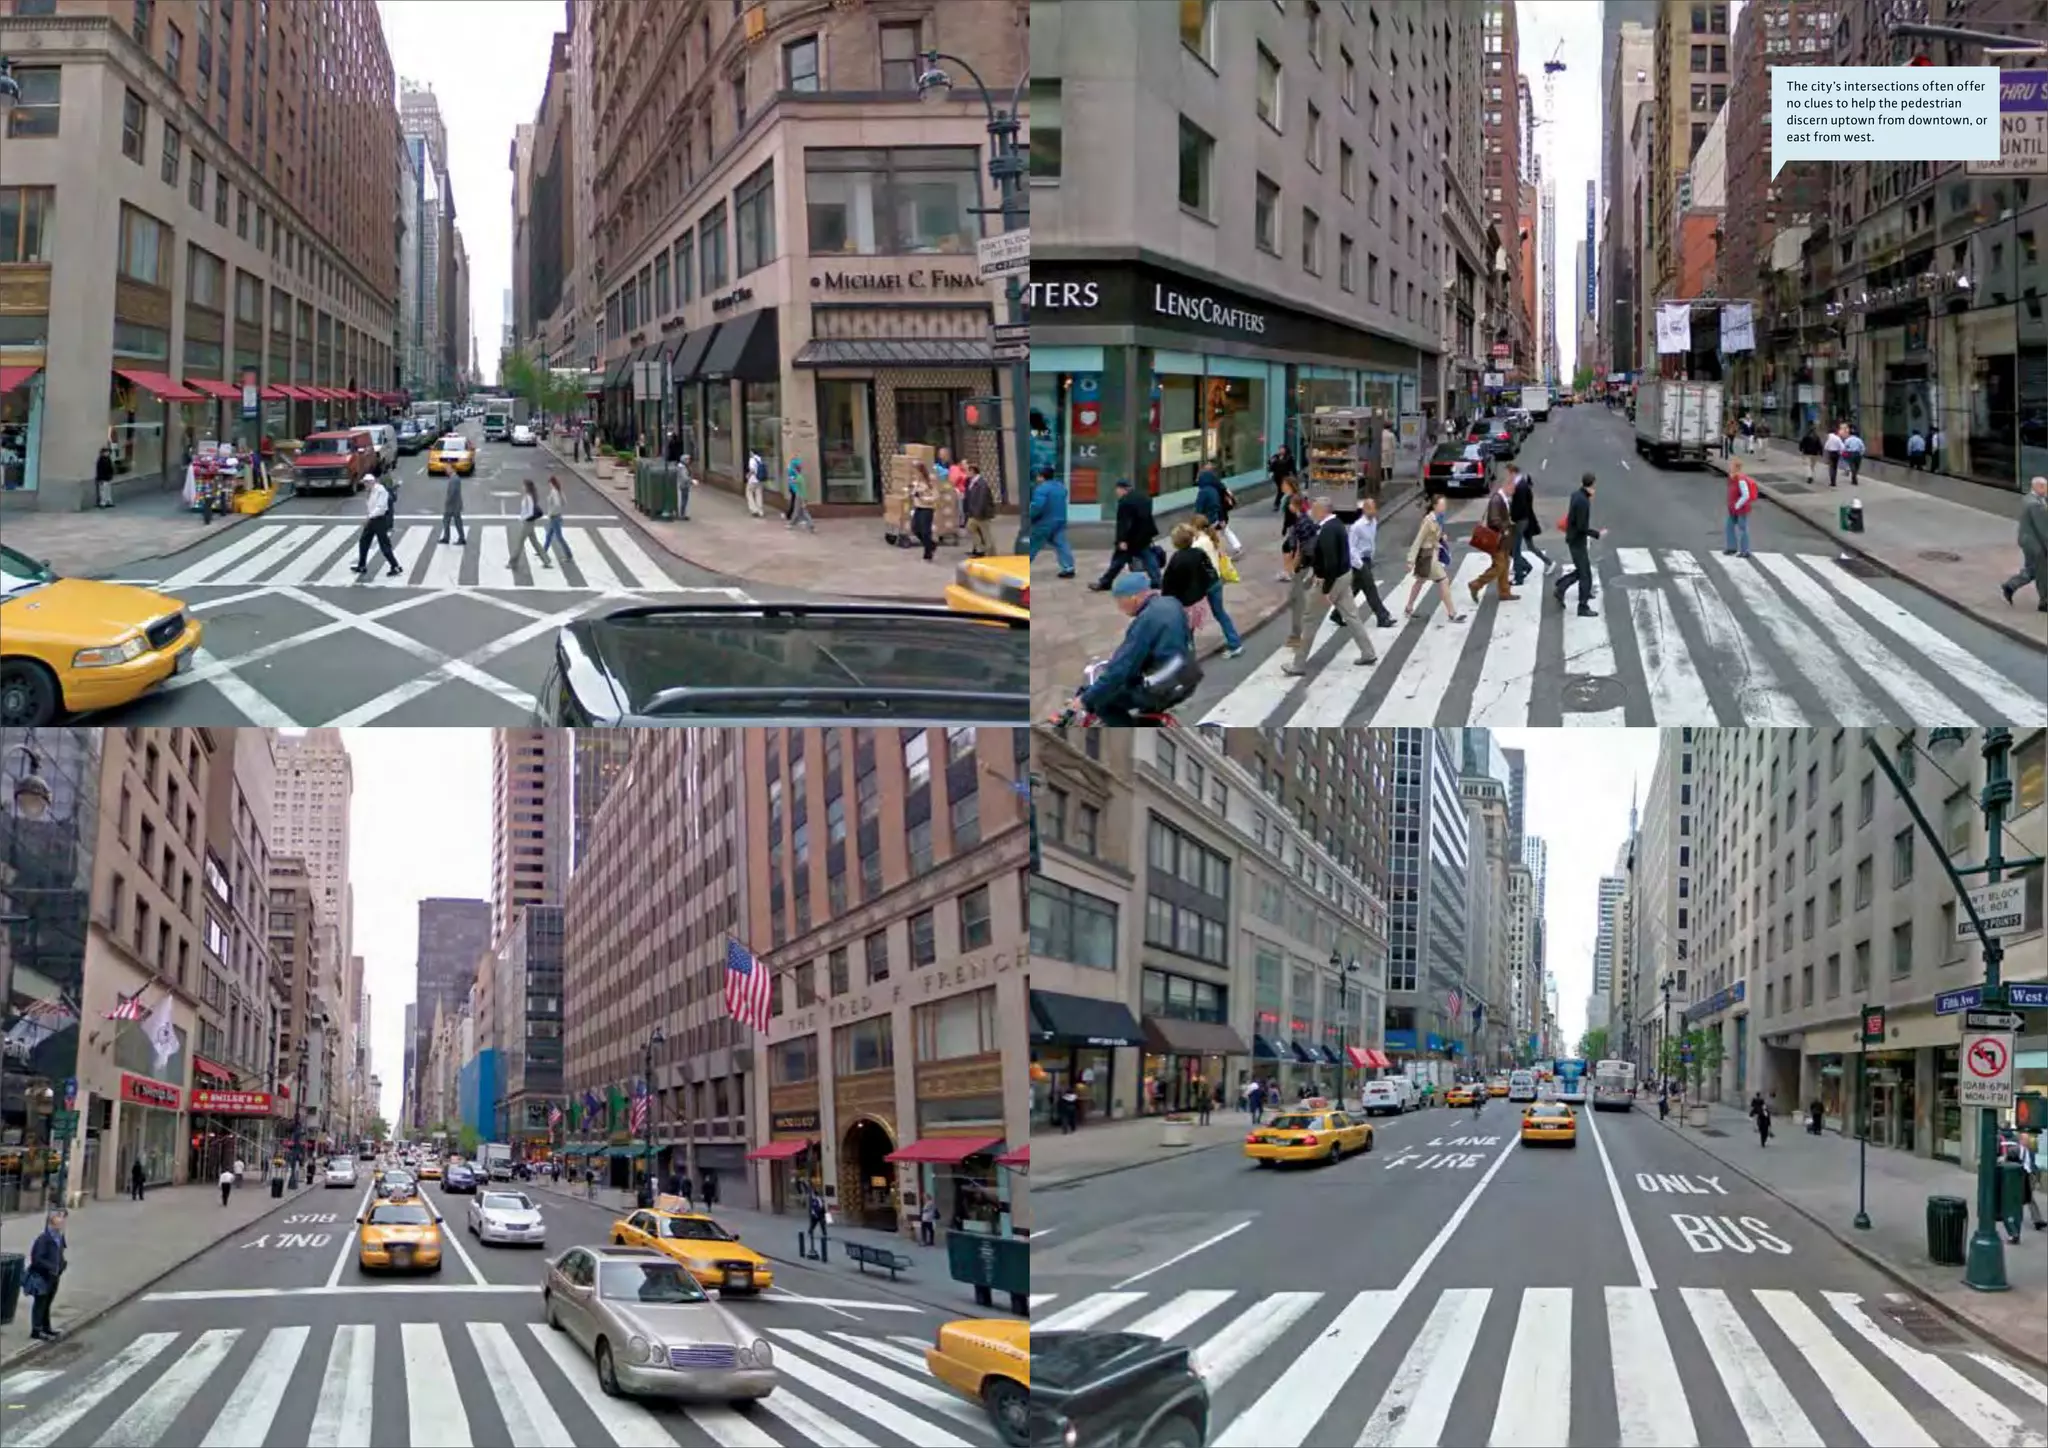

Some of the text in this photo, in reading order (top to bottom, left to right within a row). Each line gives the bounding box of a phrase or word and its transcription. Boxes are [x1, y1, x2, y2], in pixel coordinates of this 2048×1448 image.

[2002, 117, 2027, 134] NO
[2001, 138, 2046, 155] UNTIL
[824, 271, 902, 290] MICHAEL
[931, 269, 976, 288] FINA
[1080, 445, 1098, 457] LC
[1988, 887, 2020, 901] BLOCK
[1990, 901, 2009, 912] BOX
[2012, 989, 2043, 1002] West
[829, 996, 872, 1021] FRED
[1970, 1014, 2018, 1025] ONE WAY
[1427, 1135, 1500, 1146] LANE
[1384, 1153, 1487, 1169] FIRE
[1635, 1172, 1730, 1195] ONLY
[1670, 1213, 1794, 1256] BUS
